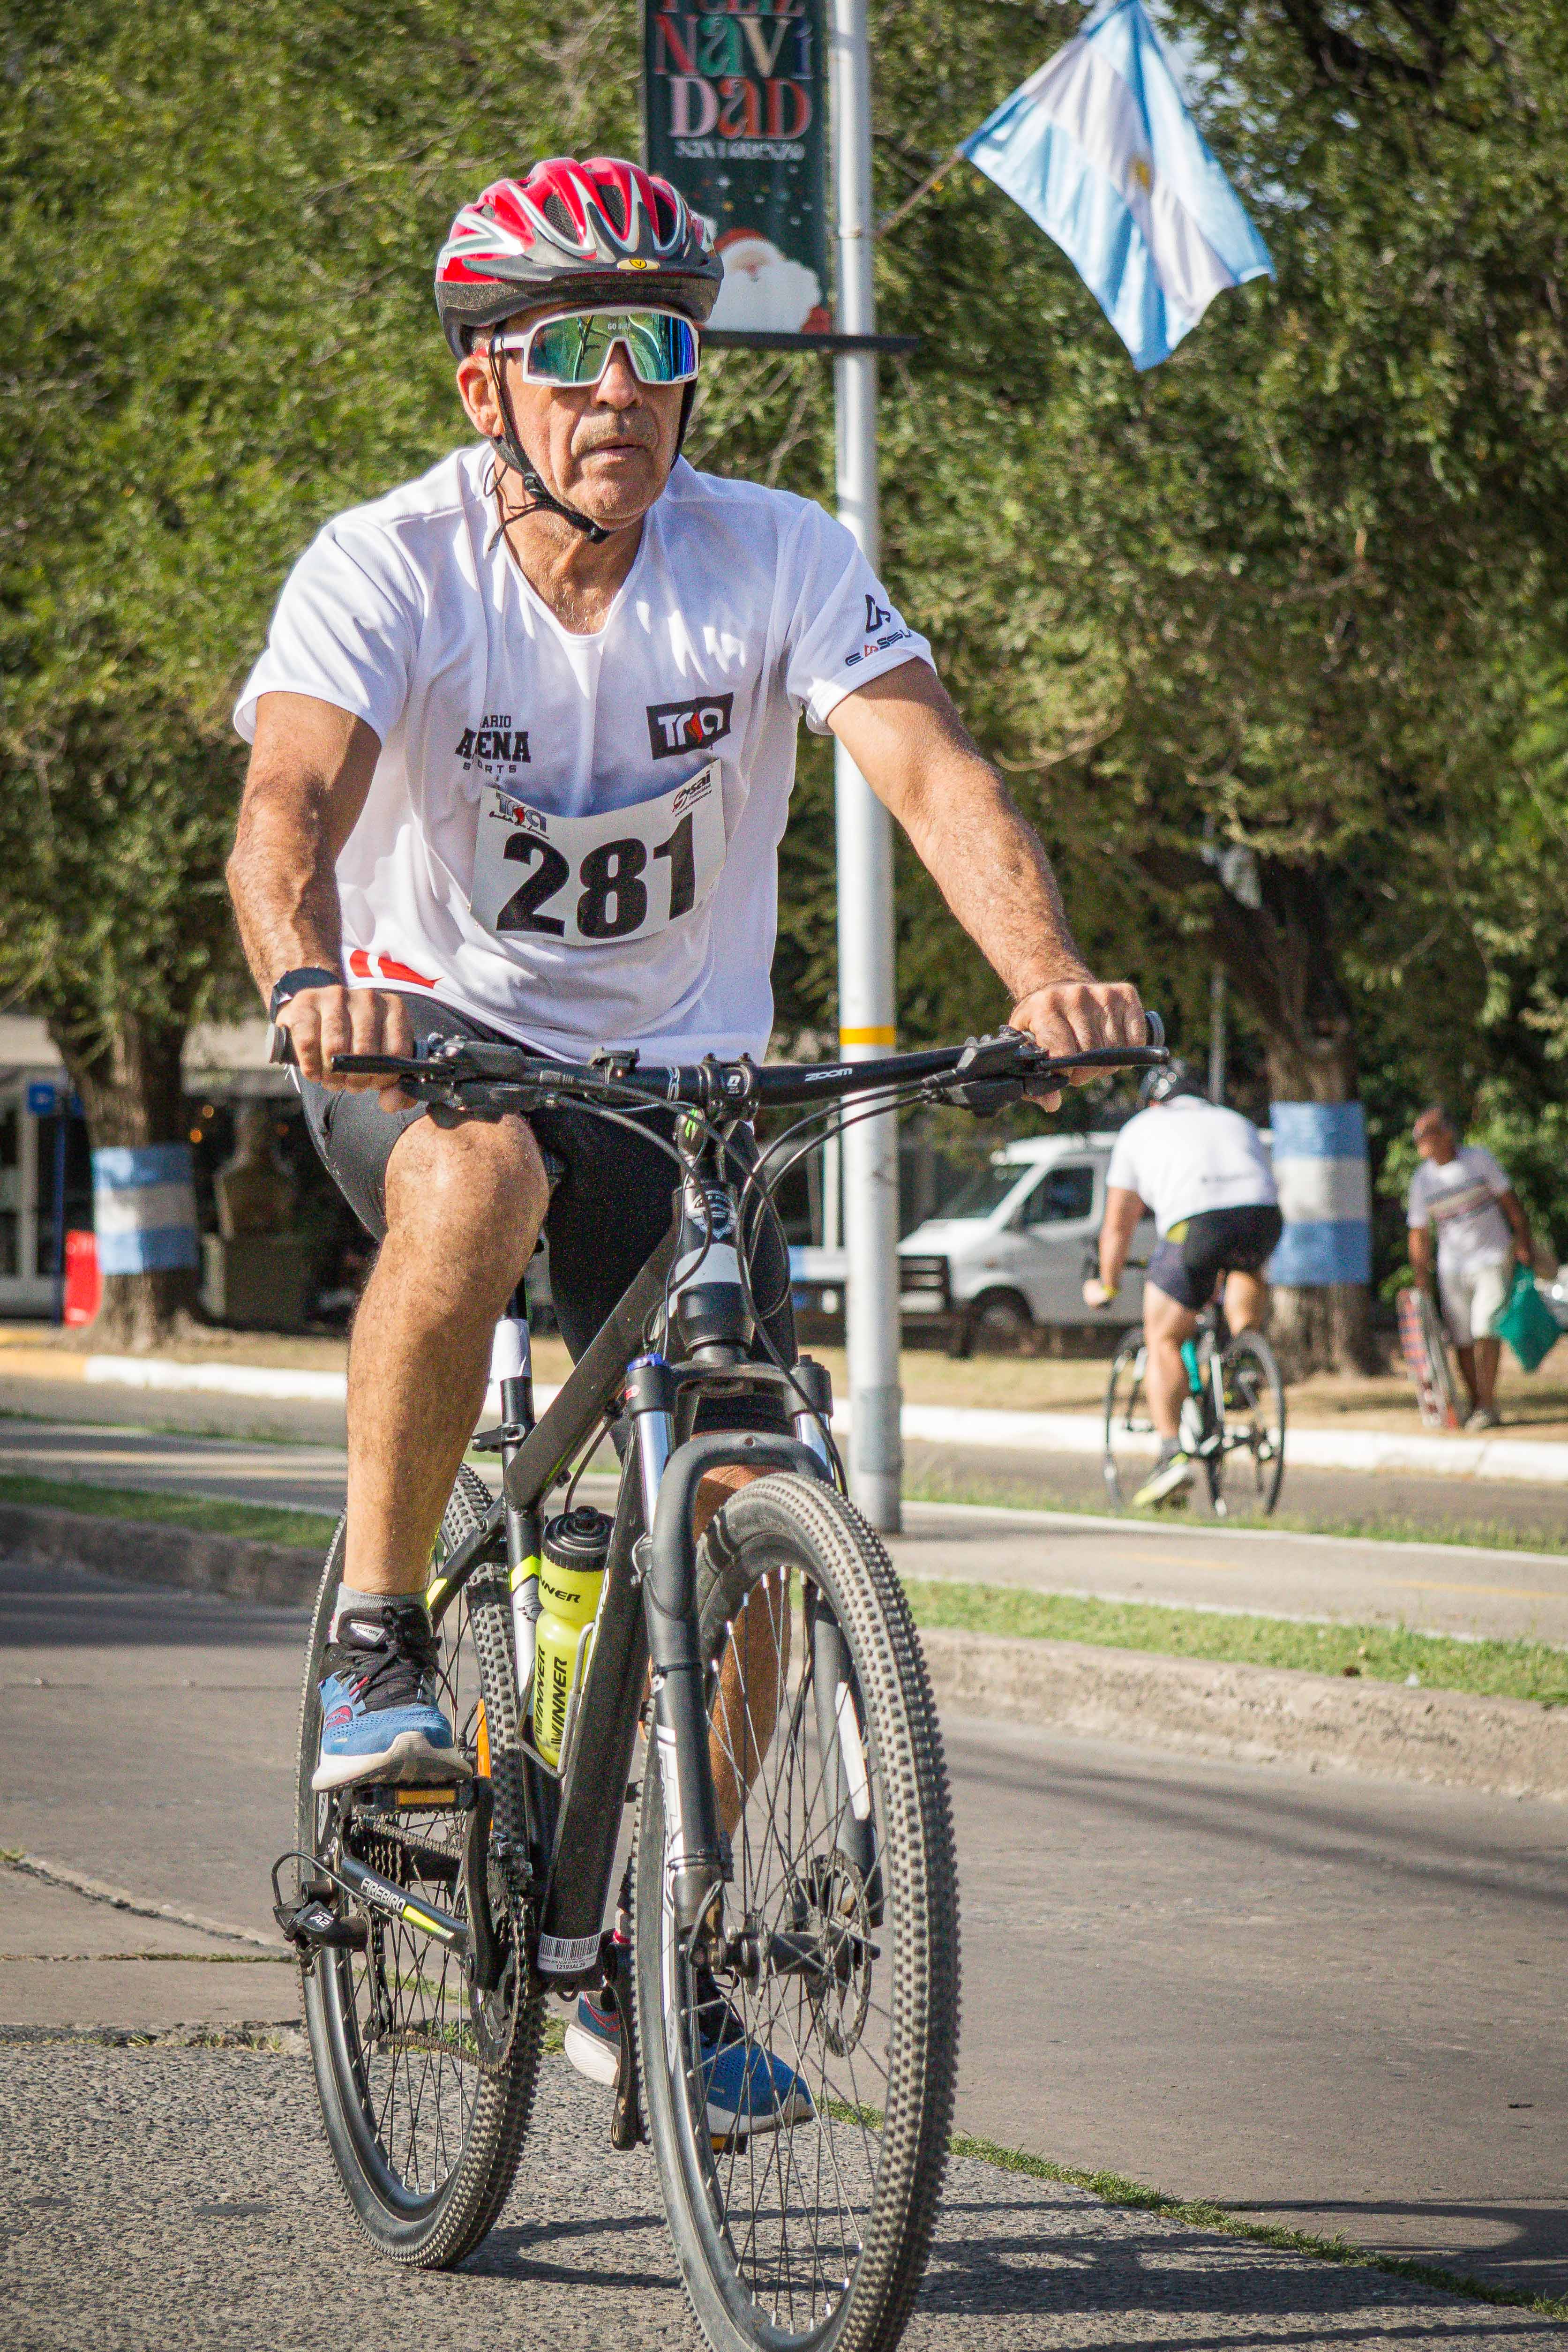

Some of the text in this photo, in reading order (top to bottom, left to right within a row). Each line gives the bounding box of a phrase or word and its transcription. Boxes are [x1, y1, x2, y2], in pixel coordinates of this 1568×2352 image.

[480, 715, 511, 728] ARIO
[454, 727, 531, 763] AENA
[463, 760, 517, 773] SORTS
[496, 811, 696, 938] 281
[540, 1576, 582, 1603] NNER
[356, 1625, 380, 1637] saucony
[535, 1644, 546, 1735] WINNER
[550, 1656, 567, 1745] WINNER
[360, 1877, 406, 1913] FIREBIRD
[309, 1914, 330, 1928] A2
